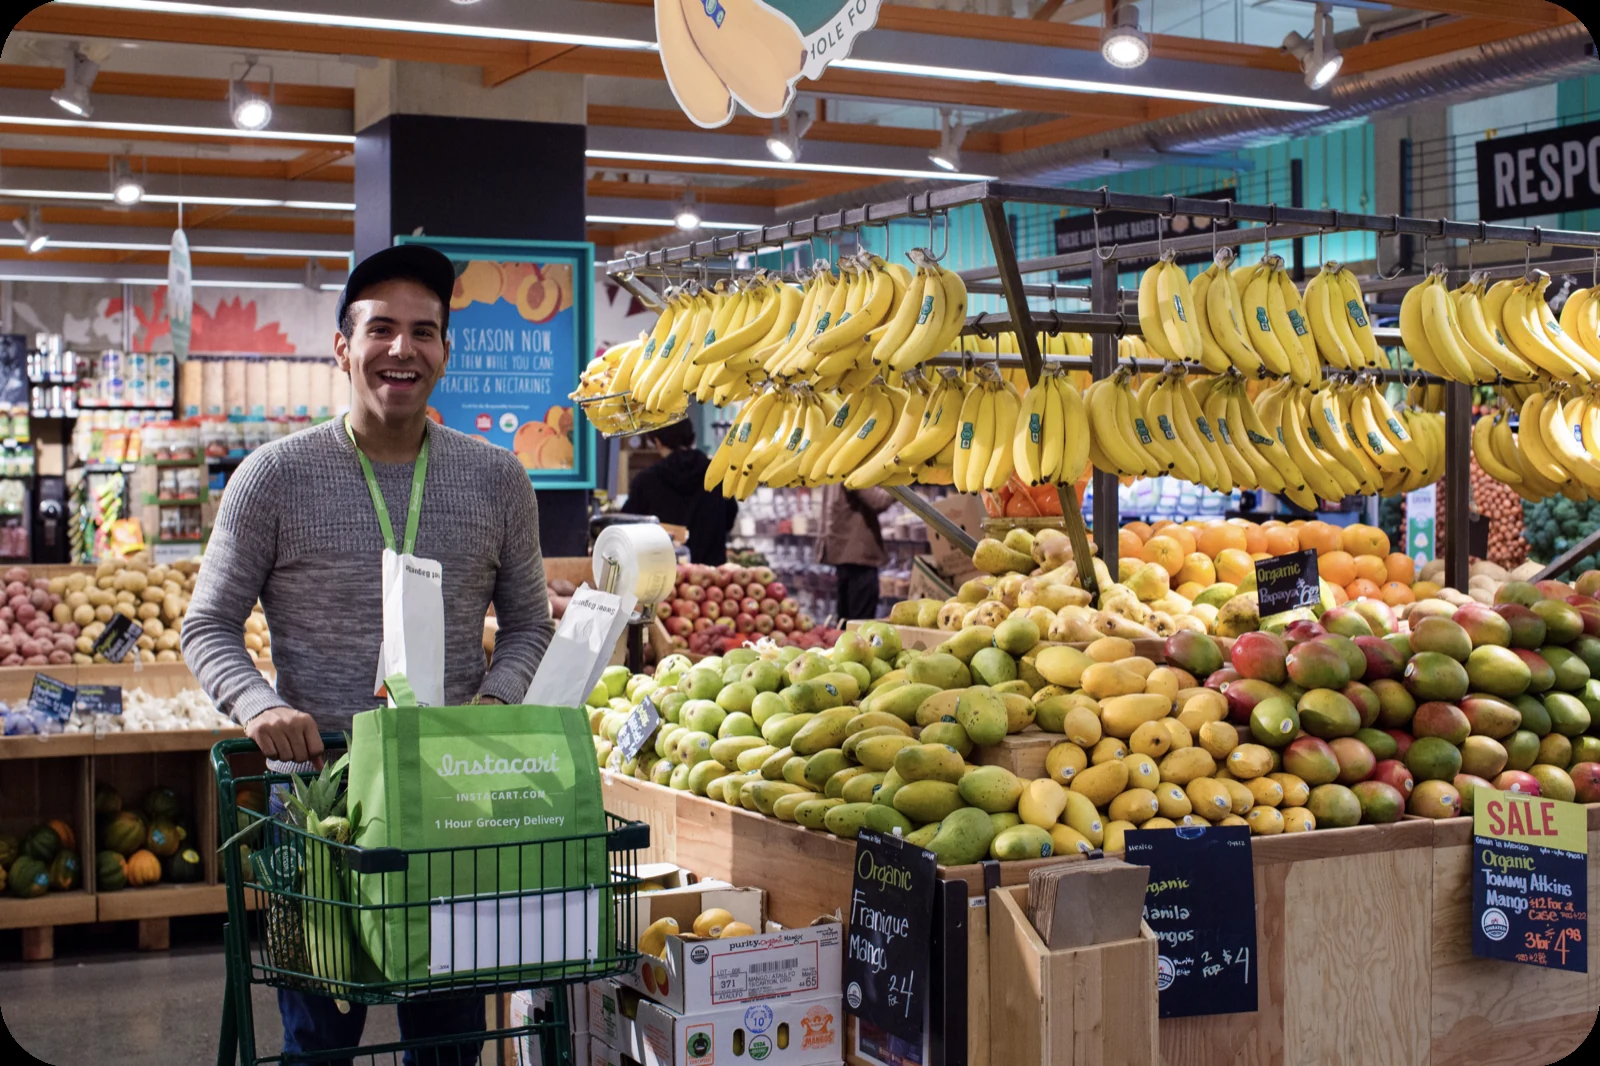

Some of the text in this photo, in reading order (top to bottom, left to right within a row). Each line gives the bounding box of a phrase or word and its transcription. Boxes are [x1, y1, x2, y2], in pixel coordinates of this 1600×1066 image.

[463, 327, 514, 353] SEASON
[461, 354, 482, 369] THEM
[486, 354, 508, 370] WHILE
[512, 355, 529, 370] YOU
[440, 376, 551, 394] PEACHES & NECTARINES
[1257, 562, 1301, 586] Organic
[1259, 588, 1299, 606] Papaya
[437, 749, 560, 777] Instacart
[456, 790, 545, 802] INSTACART.COM
[435, 815, 565, 829] 1 Hour Grocery Delivery
[1487, 800, 1558, 836] SALE
[1503, 841, 1529, 851] Mexico
[857, 849, 913, 892] Organic
[1482, 849, 1536, 874] Organic
[1146, 877, 1190, 897] rganic
[1530, 873, 1573, 896] Atkins
[1486, 889, 1528, 914] Mango
[850, 888, 910, 944] Franique
[1154, 929, 1194, 948] angos
[849, 934, 888, 974] Mango
[1201, 950, 1213, 962] 2
[720, 979, 735, 989] 371
[748, 974, 767, 982] MANGO
[900, 969, 914, 1018] 4
[753, 1017, 765, 1027] 10
